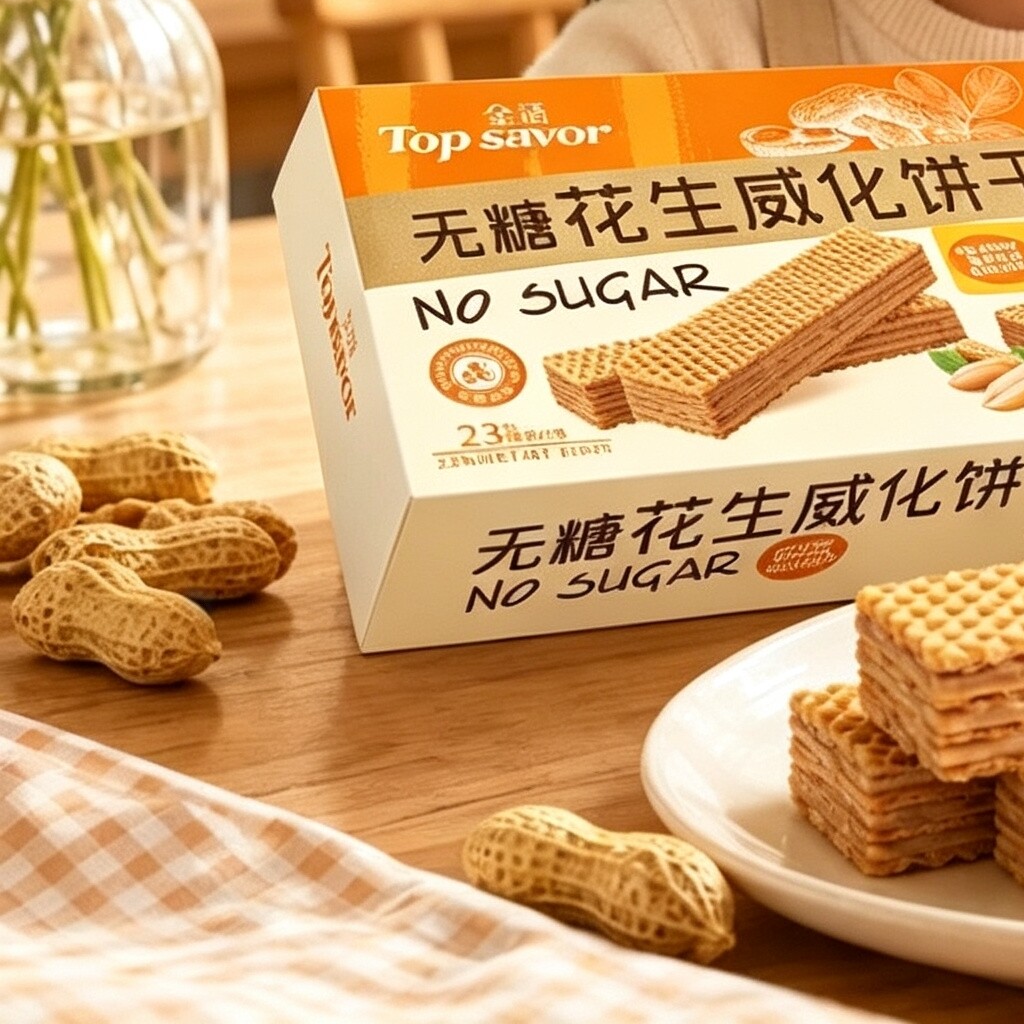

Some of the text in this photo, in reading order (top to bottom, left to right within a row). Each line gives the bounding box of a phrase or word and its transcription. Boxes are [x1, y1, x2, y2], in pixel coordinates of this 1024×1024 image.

[379, 122, 613, 162] Top savor
[412, 263, 729, 331] NO SUGAR
[465, 578, 541, 614] NO
[556, 550, 740, 601] SUGAR
